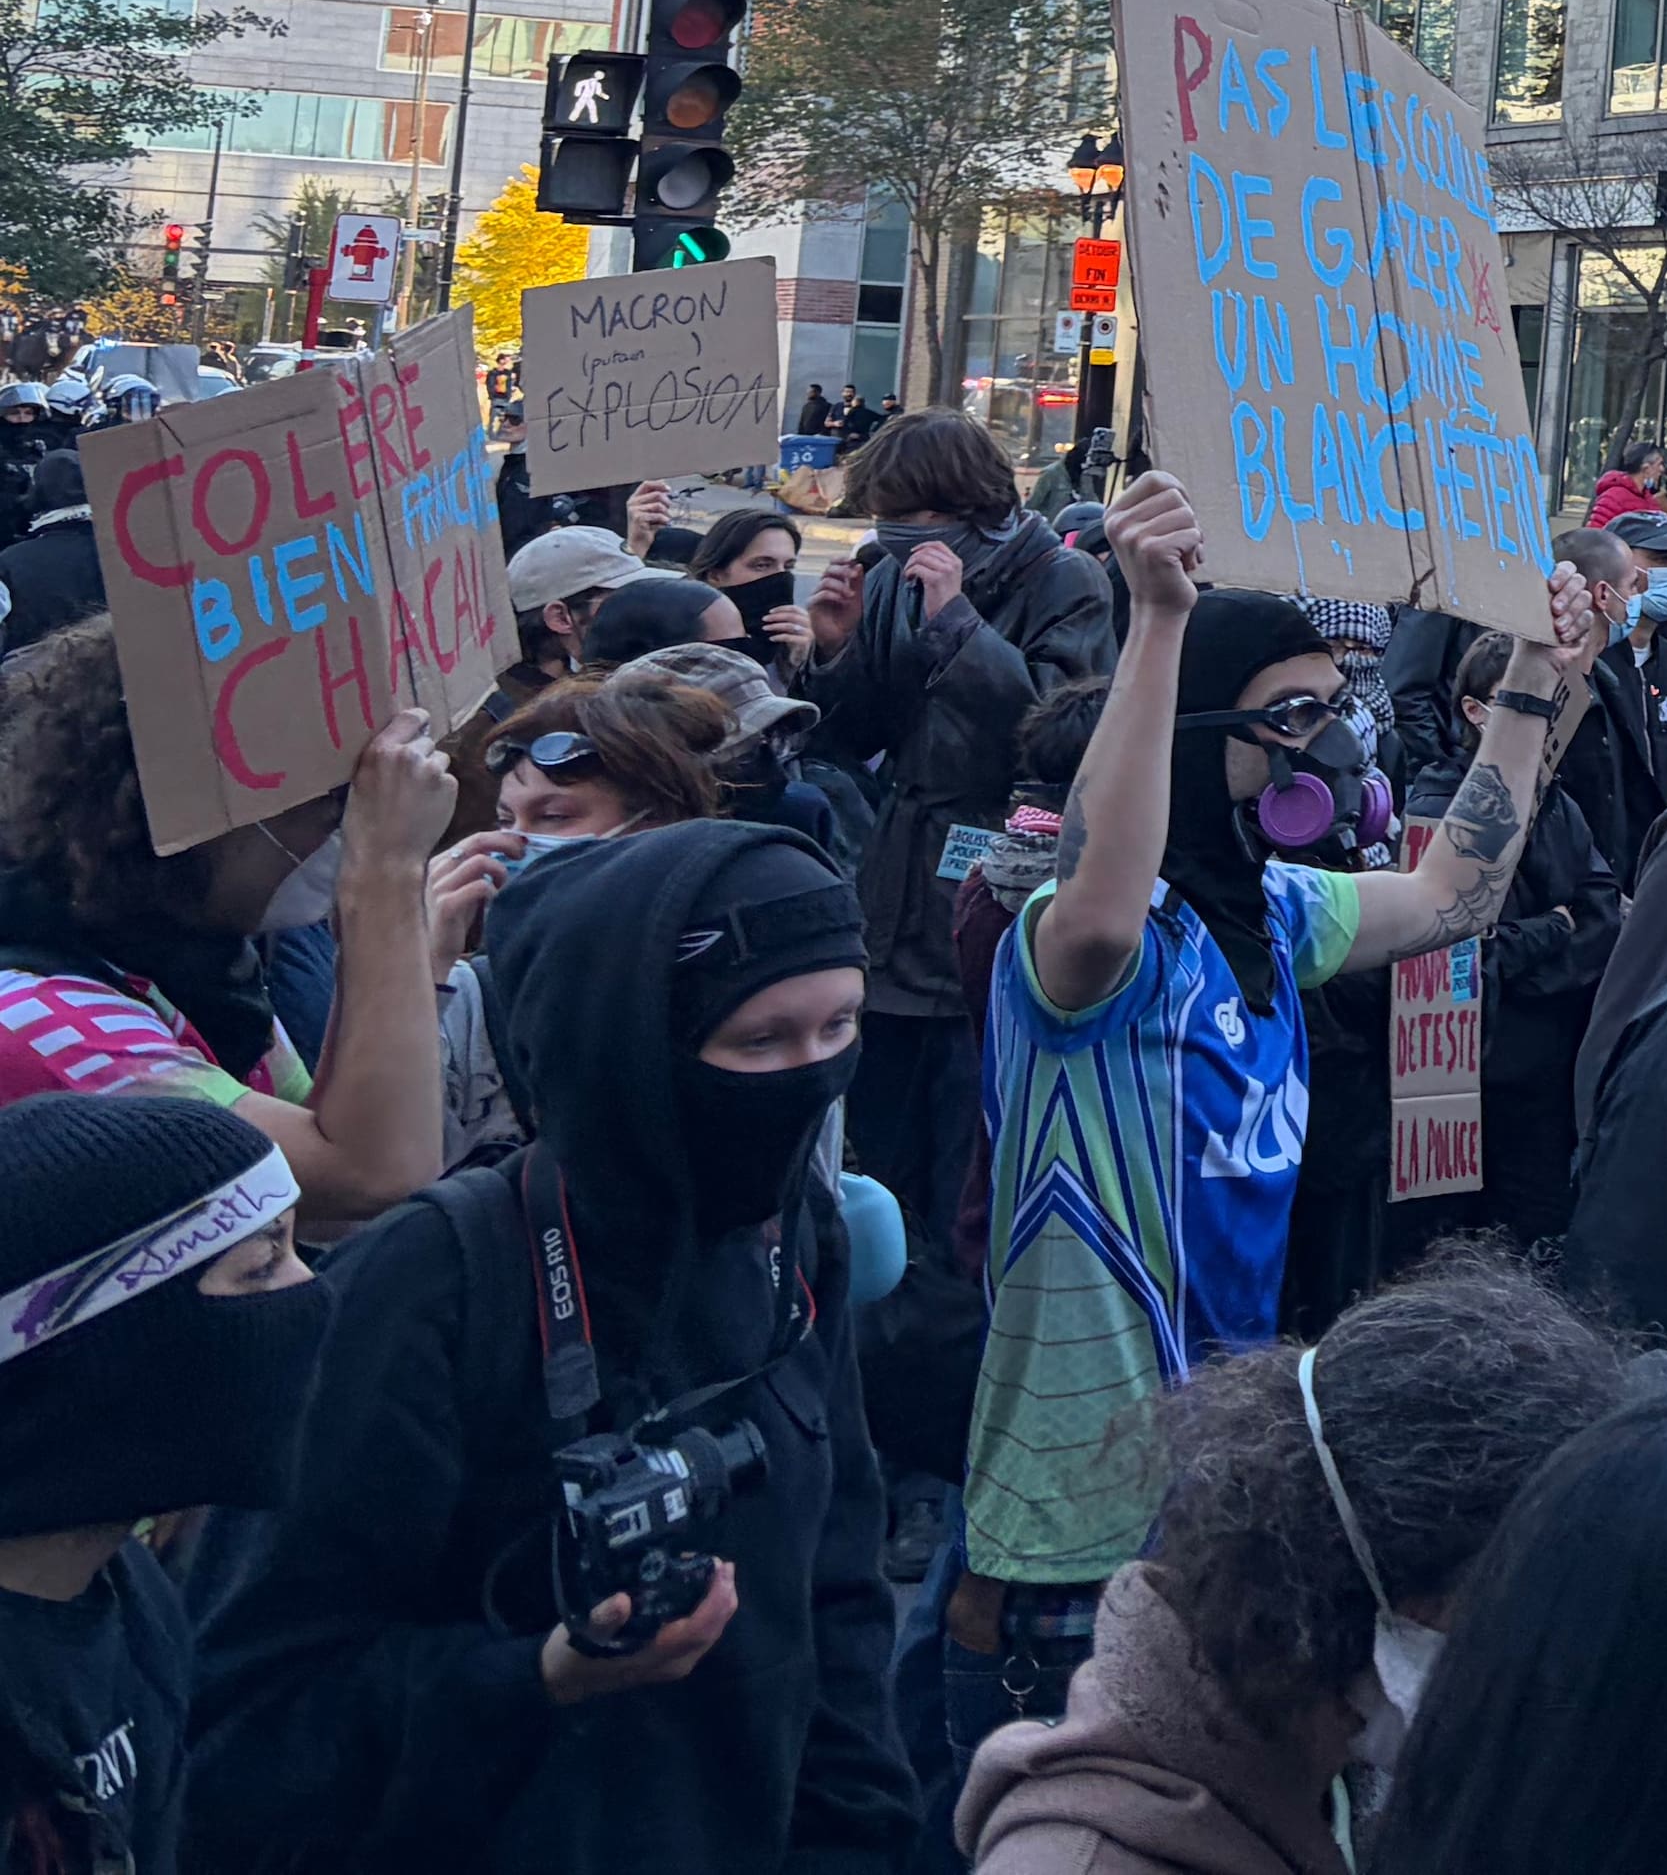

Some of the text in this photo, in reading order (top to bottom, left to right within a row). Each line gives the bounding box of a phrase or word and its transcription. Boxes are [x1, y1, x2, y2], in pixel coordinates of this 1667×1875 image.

[1174, 15, 1290, 143] PAS
[1187, 151, 1472, 316] DE GAZER
[570, 280, 728, 339] MACRON
[1210, 289, 1490, 421] UN HOMME
[546, 366, 778, 452] EXPLOSION
[113, 361, 433, 589] COLÈRE
[192, 511, 377, 663] BIEN
[212, 536, 498, 790] CHACAL
[1395, 1116, 1479, 1194] LA POLICE
[542, 1227, 576, 1321] EOS R10
